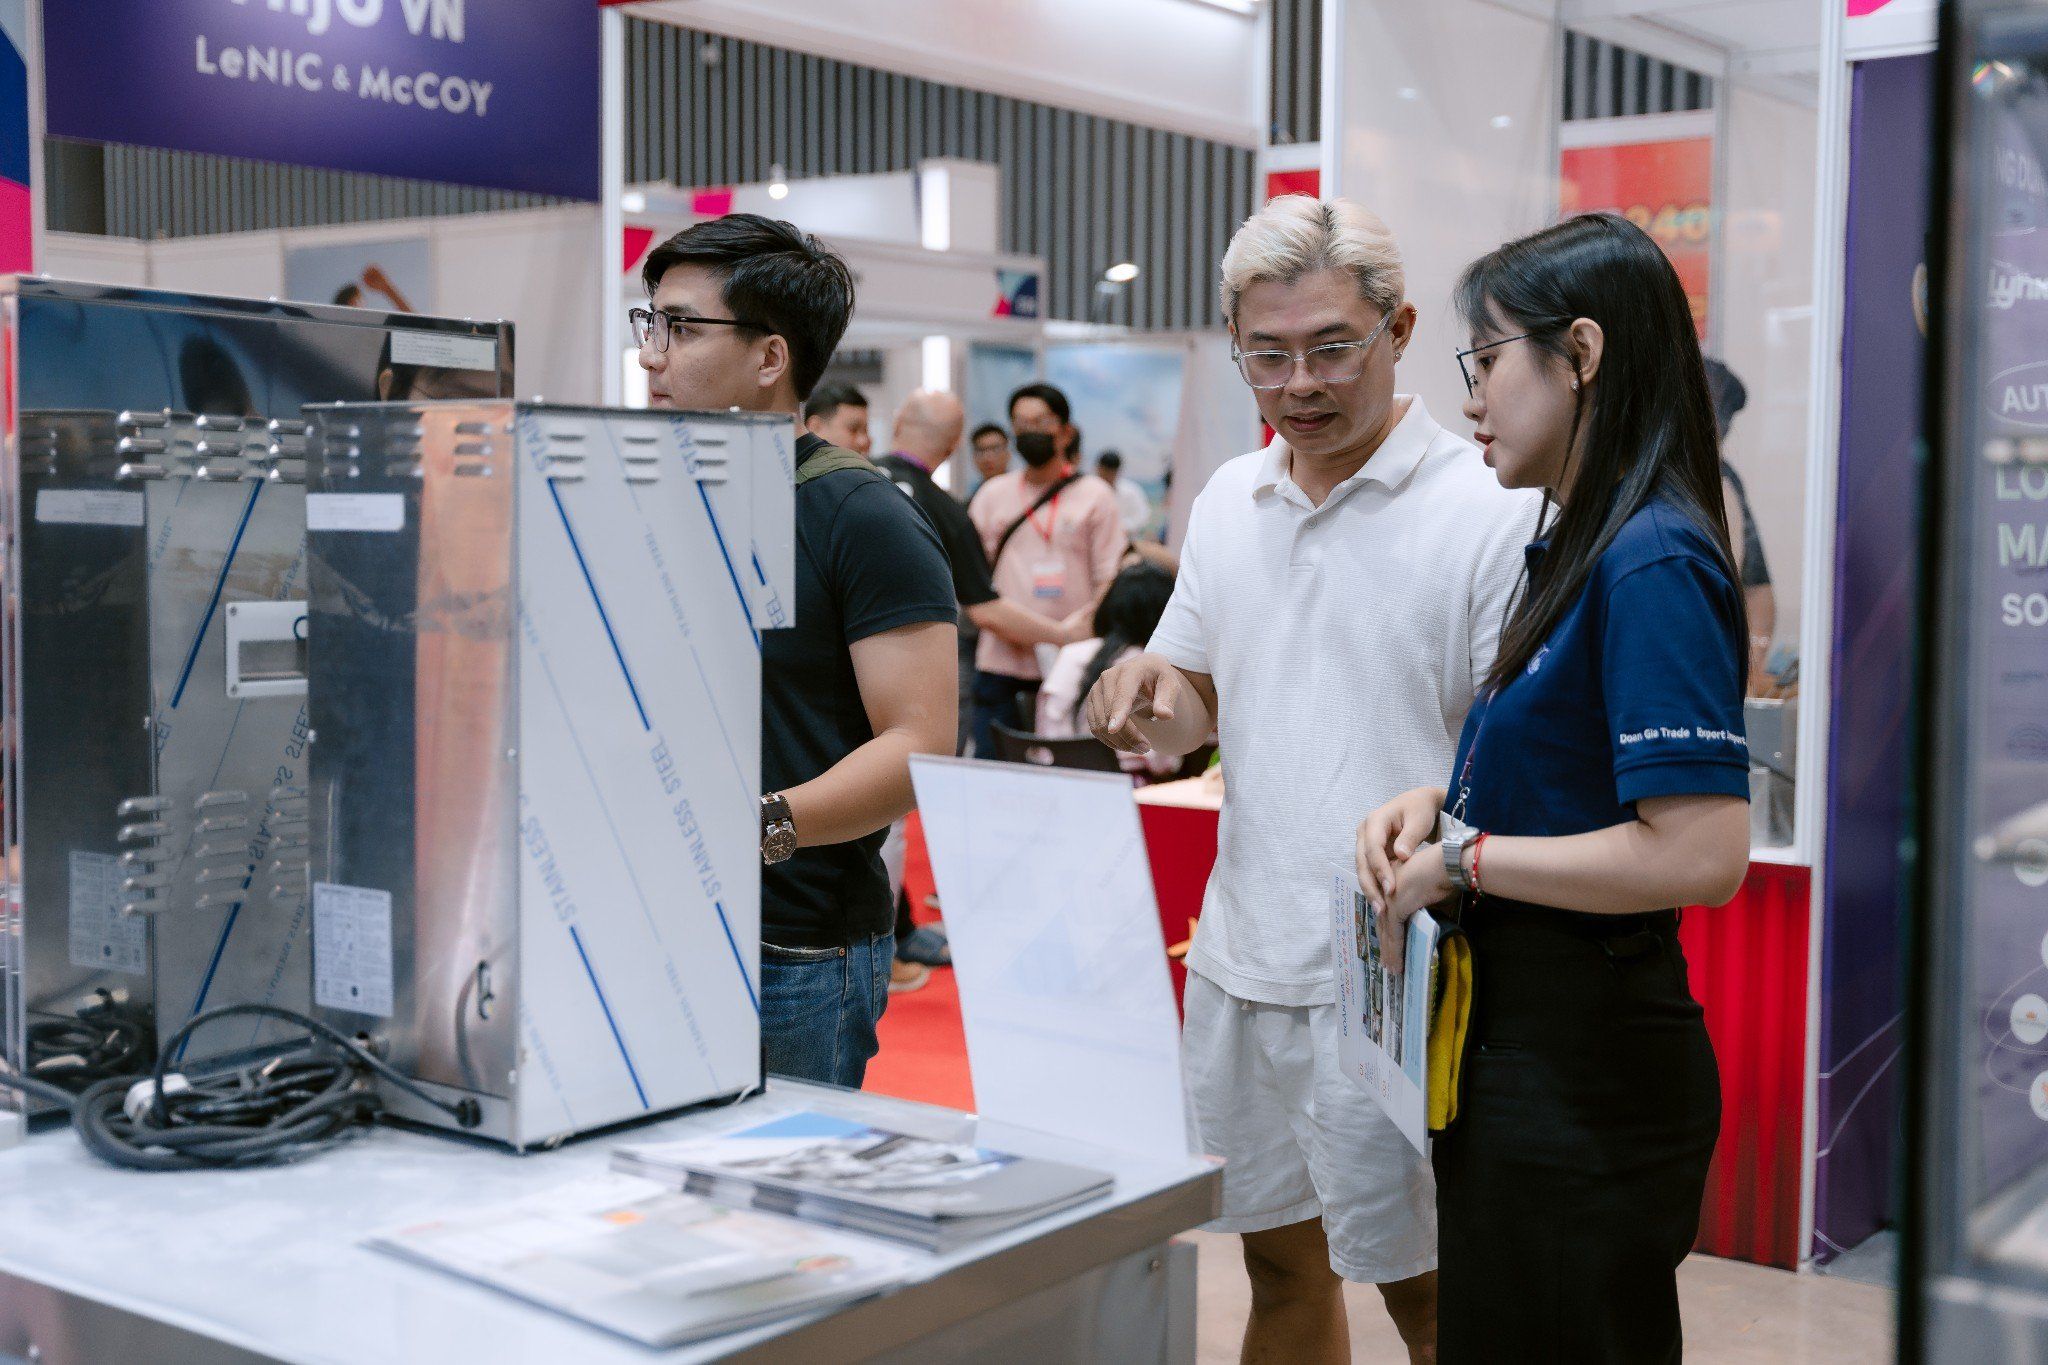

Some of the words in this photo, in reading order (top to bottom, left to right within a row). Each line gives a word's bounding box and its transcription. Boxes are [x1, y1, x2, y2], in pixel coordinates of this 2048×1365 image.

[196, 35, 324, 91] LeNIC
[332, 64, 351, 91] &
[358, 64, 494, 117] McCOY
[649, 733, 683, 795] STEEL
[1619, 732, 1643, 744] Doan
[1644, 728, 1659, 739] Gia
[1660, 727, 1691, 738] Trade
[521, 815, 577, 922] STAINLESS
[673, 798, 722, 899] STAINLESS
